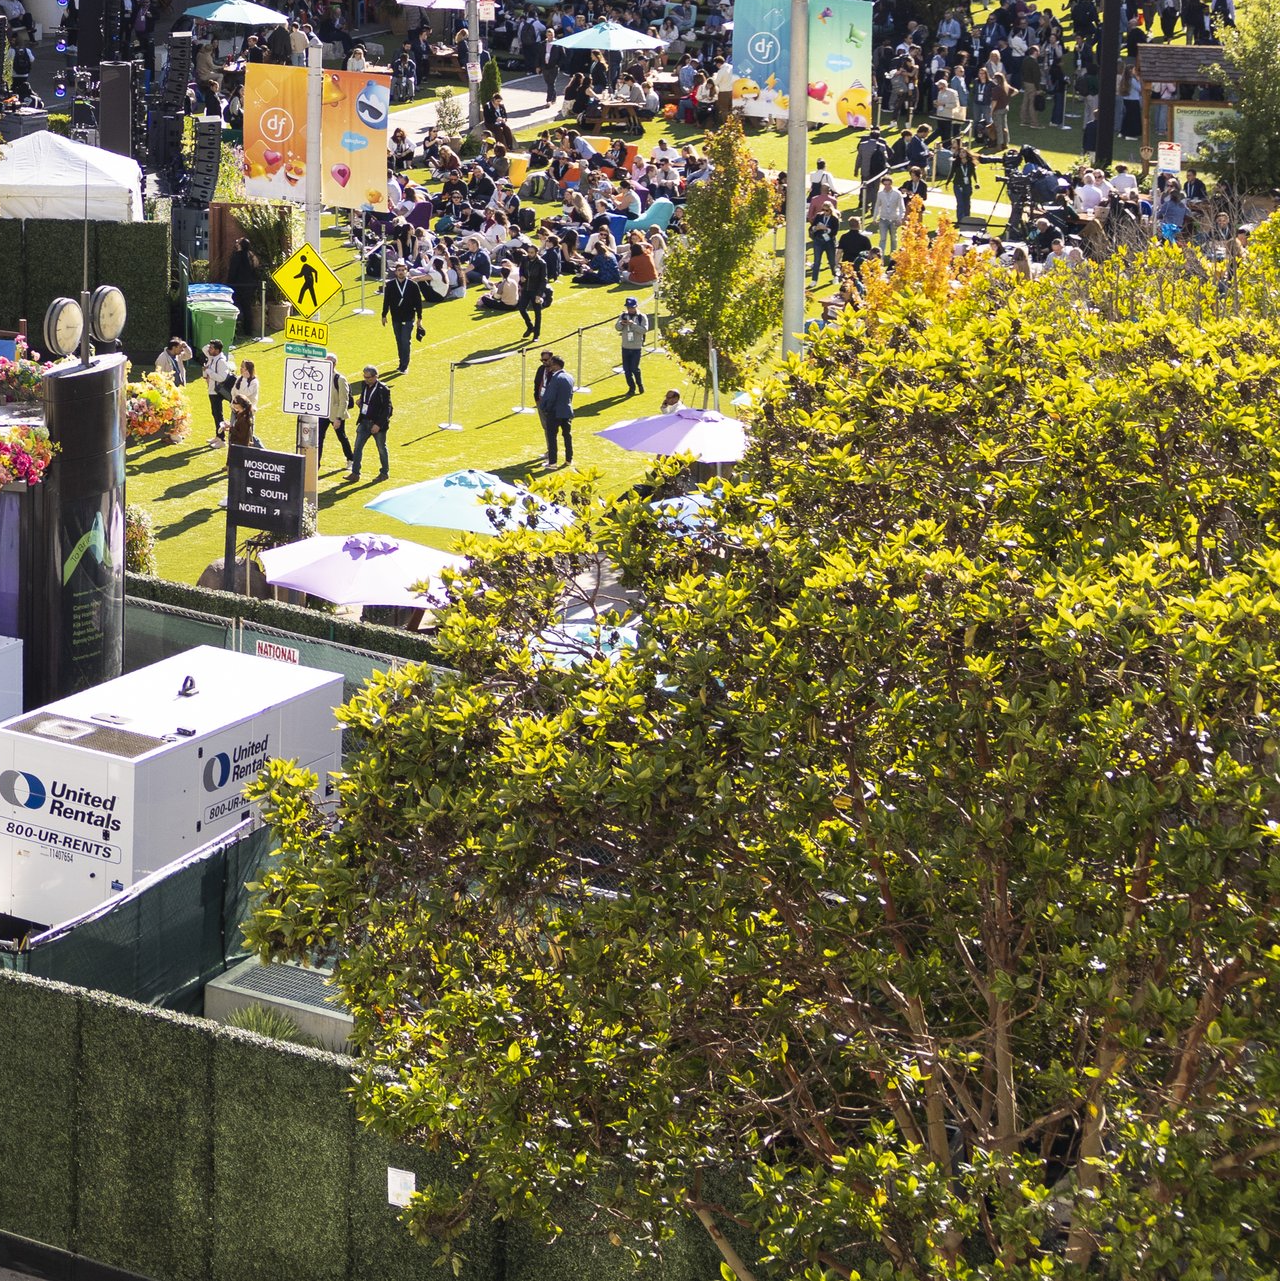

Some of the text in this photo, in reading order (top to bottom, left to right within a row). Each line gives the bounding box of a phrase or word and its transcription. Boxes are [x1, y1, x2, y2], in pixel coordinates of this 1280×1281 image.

[754, 37, 774, 60] df
[1176, 108, 1216, 117] Dreamforce
[266, 114, 287, 138] df
[290, 323, 325, 340] AHEAD
[292, 381, 323, 392] YIELD
[301, 392, 314, 400] TO
[292, 401, 321, 412] PEDS
[244, 459, 286, 474] MOSCONE
[248, 469, 281, 482] CENTER
[260, 488, 288, 501] SOUTH
[238, 502, 267, 515] NORTH
[257, 641, 298, 664] NATIONAL
[232, 734, 270, 764] United
[231, 754, 271, 783] Rentals
[50, 780, 117, 812] United
[49, 799, 122, 832] Rentals
[6, 821, 113, 859] 800-UR-RENTS
[49, 848, 74, 862] 11407654
